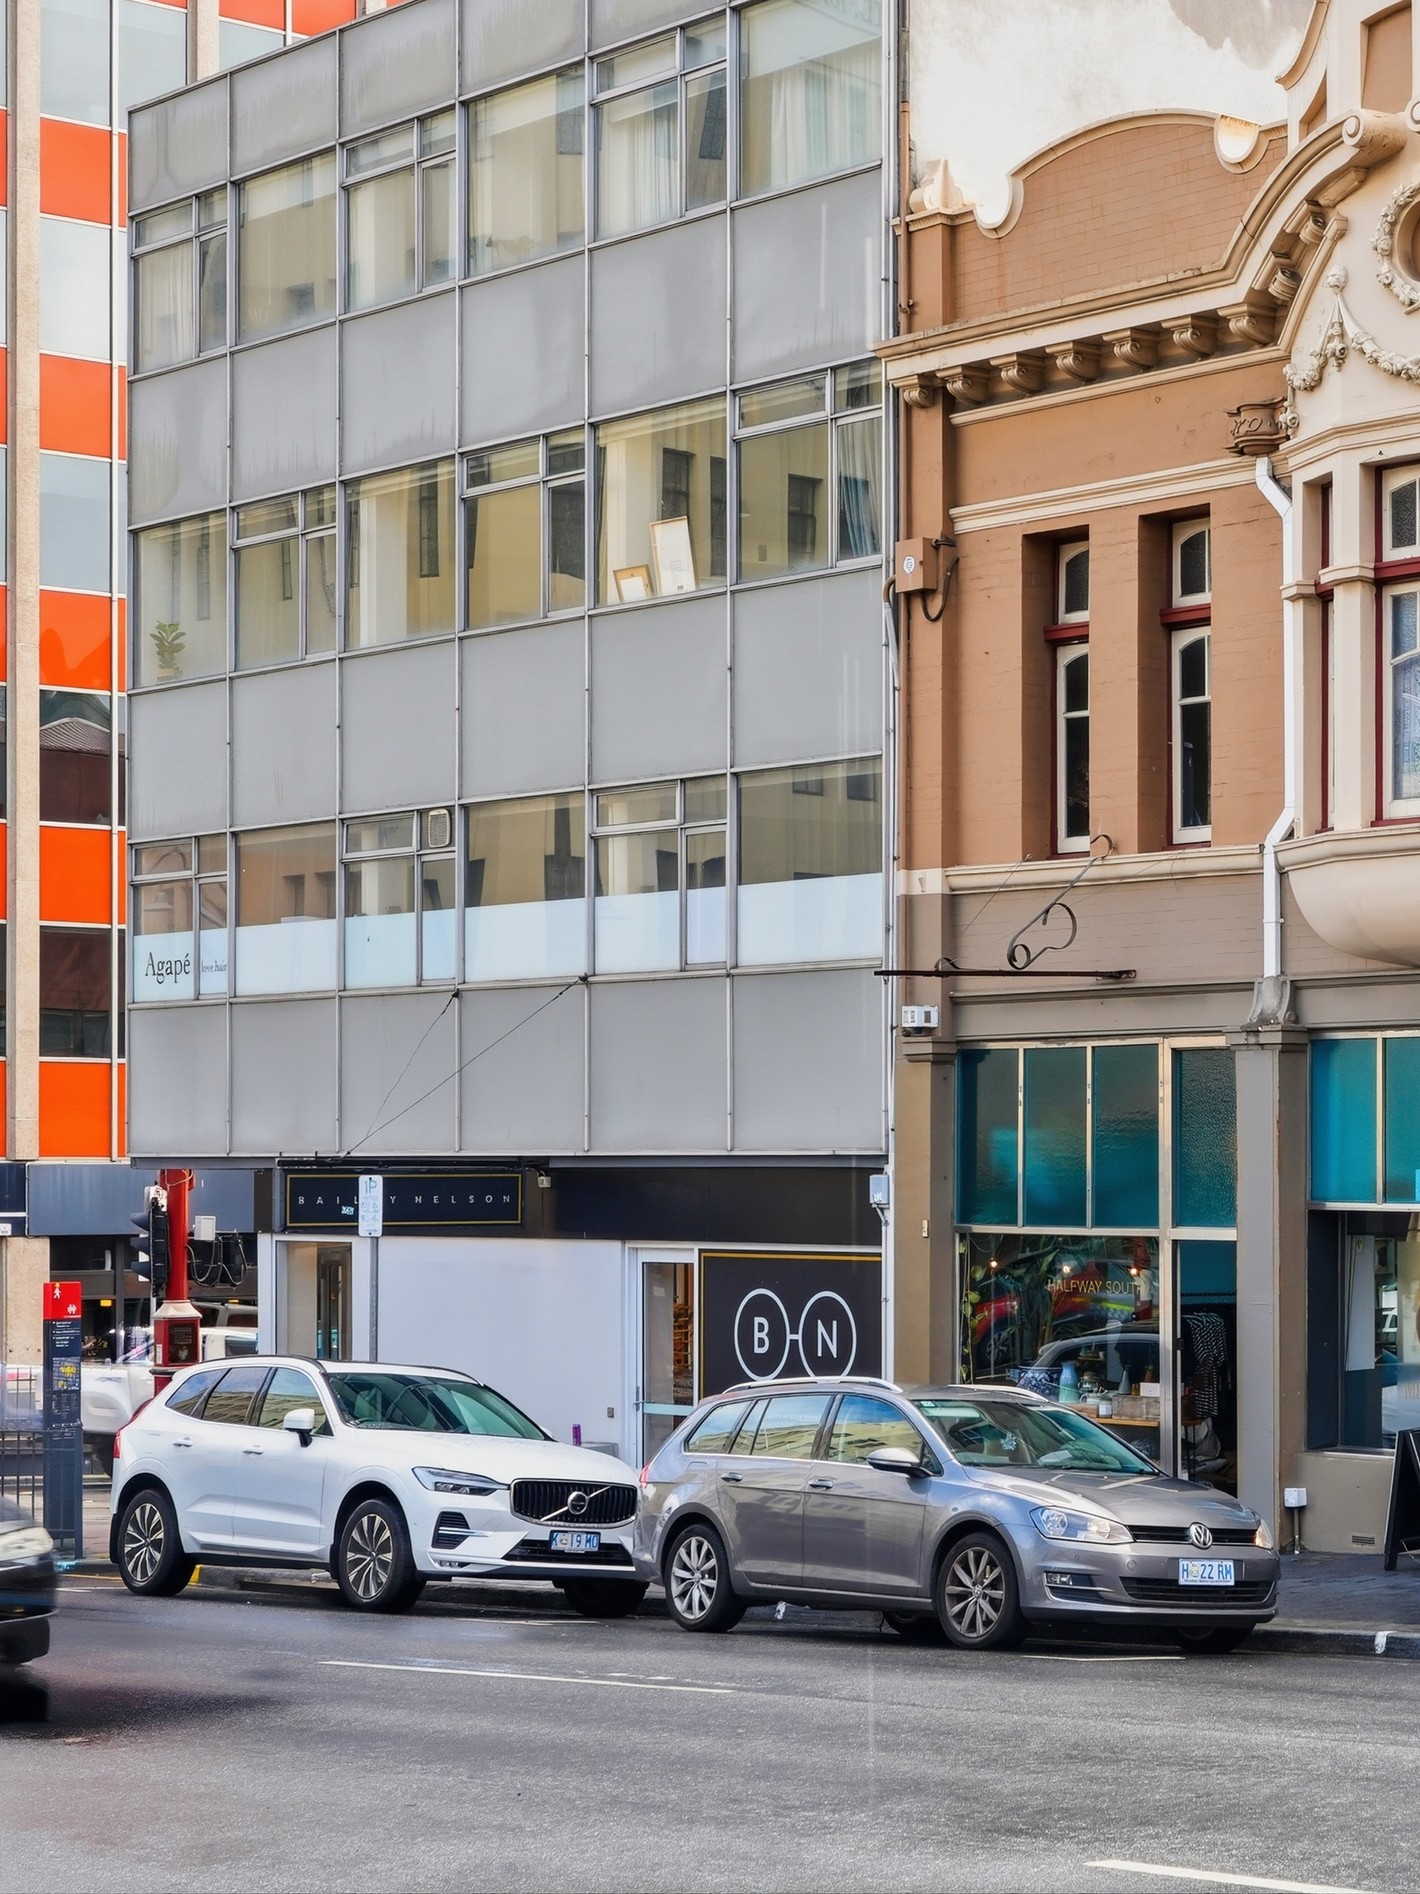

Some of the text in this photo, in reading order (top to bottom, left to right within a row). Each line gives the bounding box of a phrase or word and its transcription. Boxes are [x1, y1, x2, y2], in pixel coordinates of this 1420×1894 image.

[144, 951, 191, 985] Agapé
[298, 1193, 510, 1206] BAILY NELSON
[1047, 1279, 1102, 1294] HALFWAY
[1200, 1563, 1214, 1580] 22
